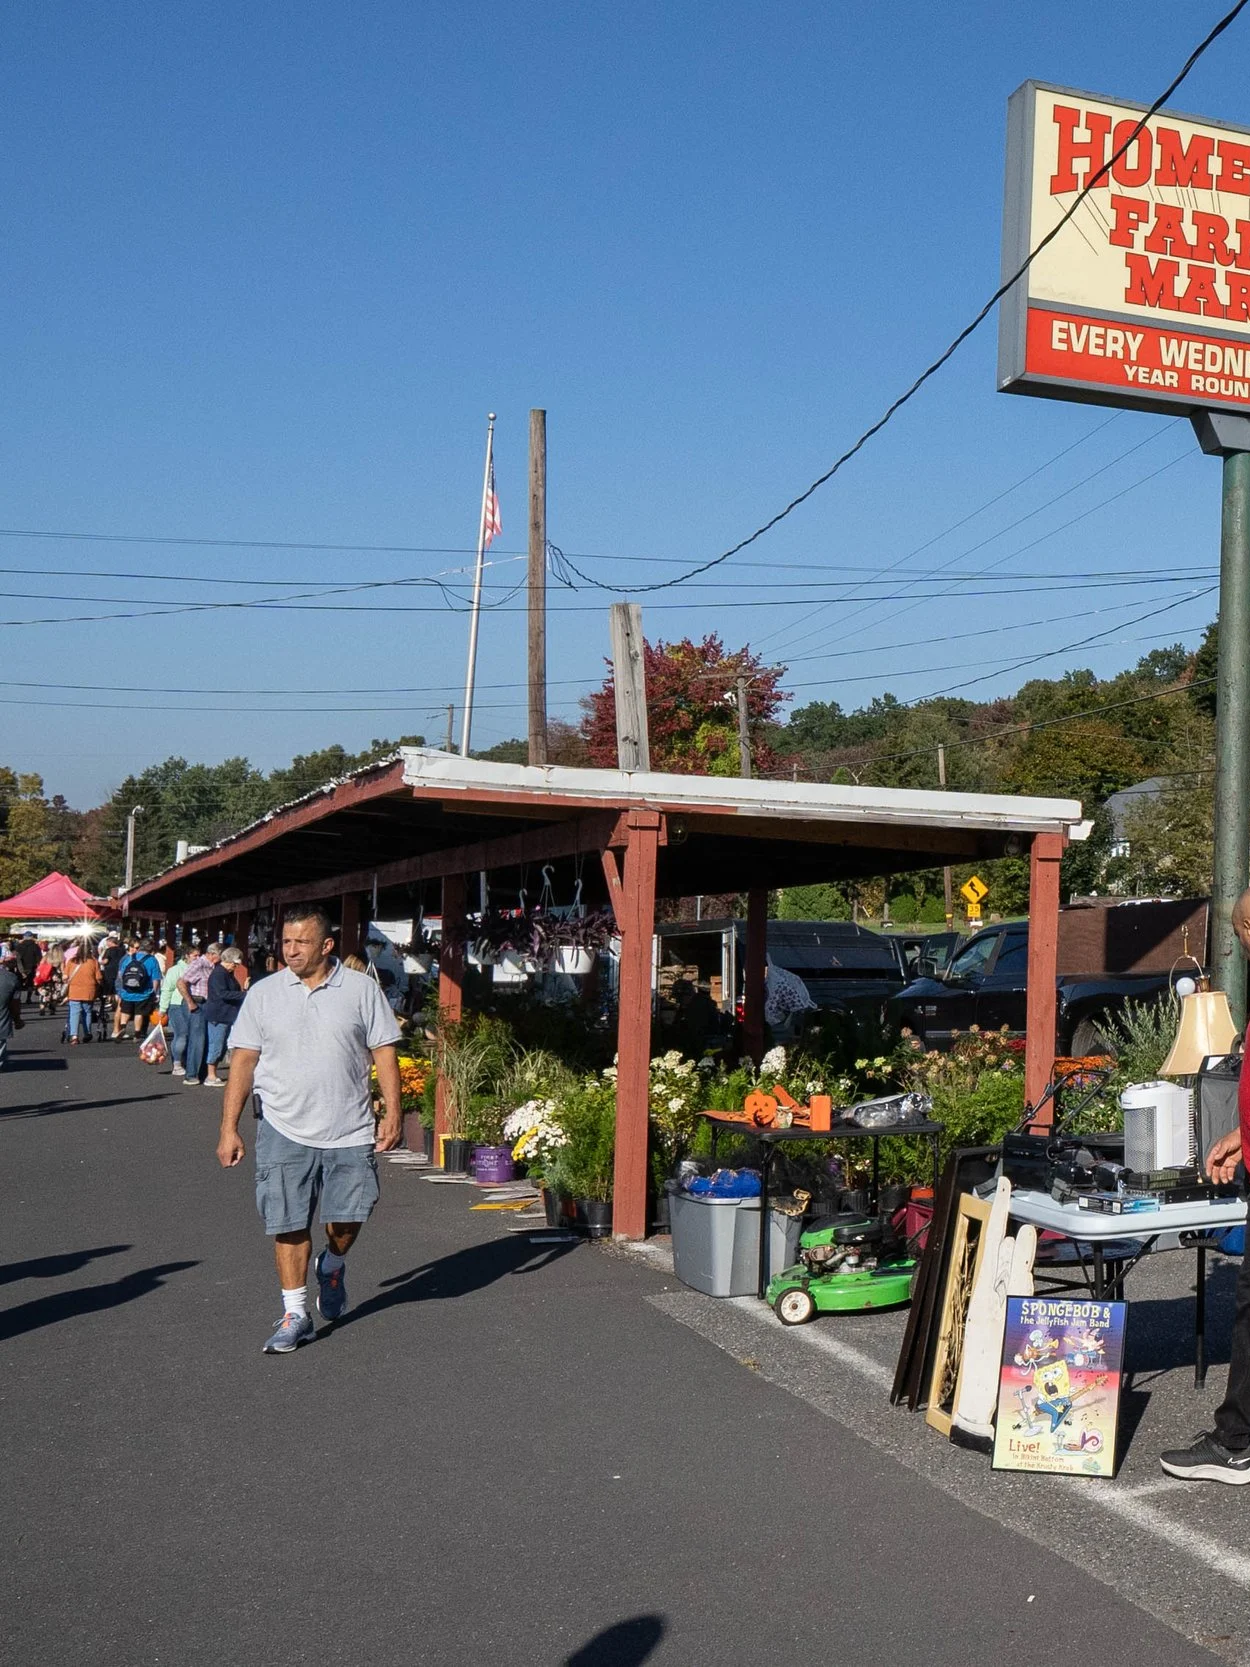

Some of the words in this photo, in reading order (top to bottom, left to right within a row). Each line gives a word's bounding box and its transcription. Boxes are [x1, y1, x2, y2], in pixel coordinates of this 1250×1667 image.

[1051, 320, 1145, 361] EVERY
[1125, 365, 1179, 389] YEAR
[1022, 1302, 1099, 1318] SPONGEBOB
[1103, 1308, 1110, 1319] &
[1021, 1316, 1034, 1324] the
[1071, 1318, 1086, 1327] Jam
[1089, 1318, 1110, 1328] Band
[1009, 1439, 1041, 1453] Live!
